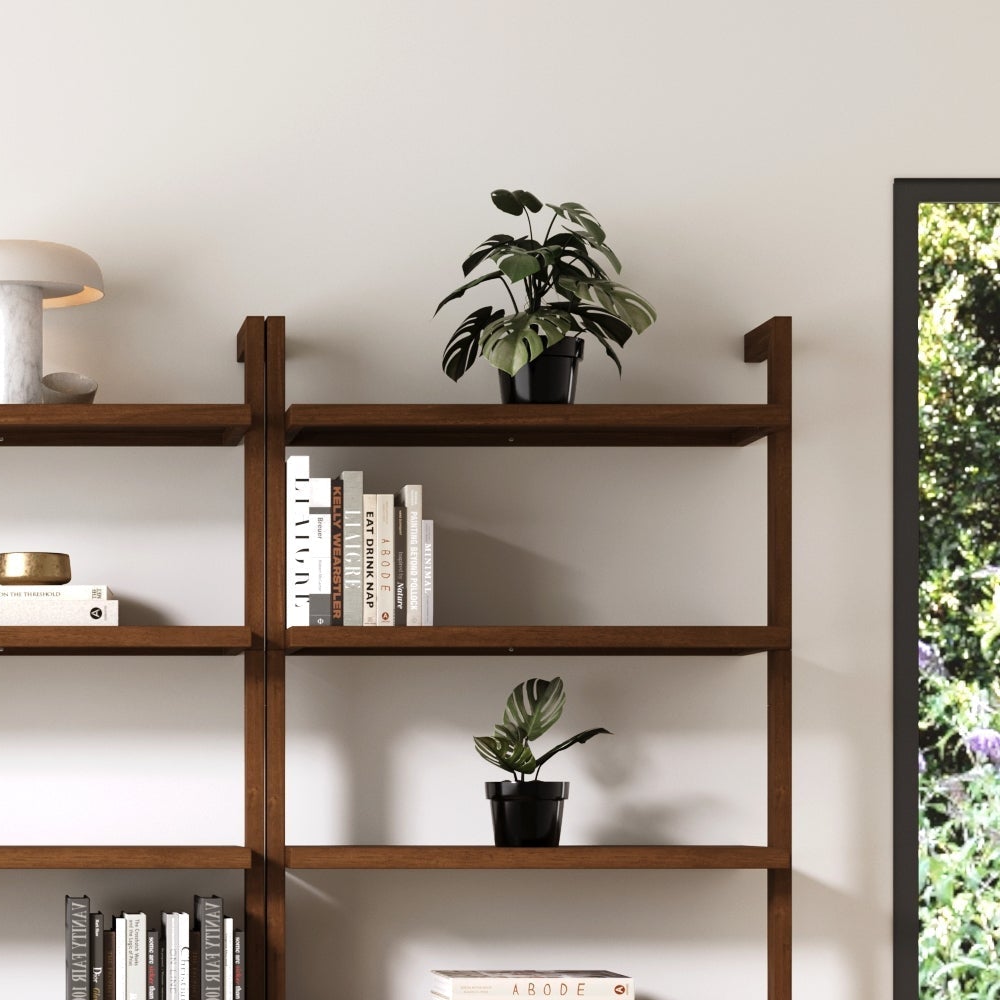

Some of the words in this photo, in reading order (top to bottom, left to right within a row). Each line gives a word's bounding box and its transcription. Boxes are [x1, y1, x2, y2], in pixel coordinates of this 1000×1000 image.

[333, 486, 342, 529] KELLY
[366, 511, 374, 534] EAT
[344, 510, 361, 590] LIAIGRE
[366, 538, 374, 578] DRINK
[333, 533, 342, 620] WEARSTLER
[366, 582, 374, 608] NAP
[92, 967, 102, 983] Dior
